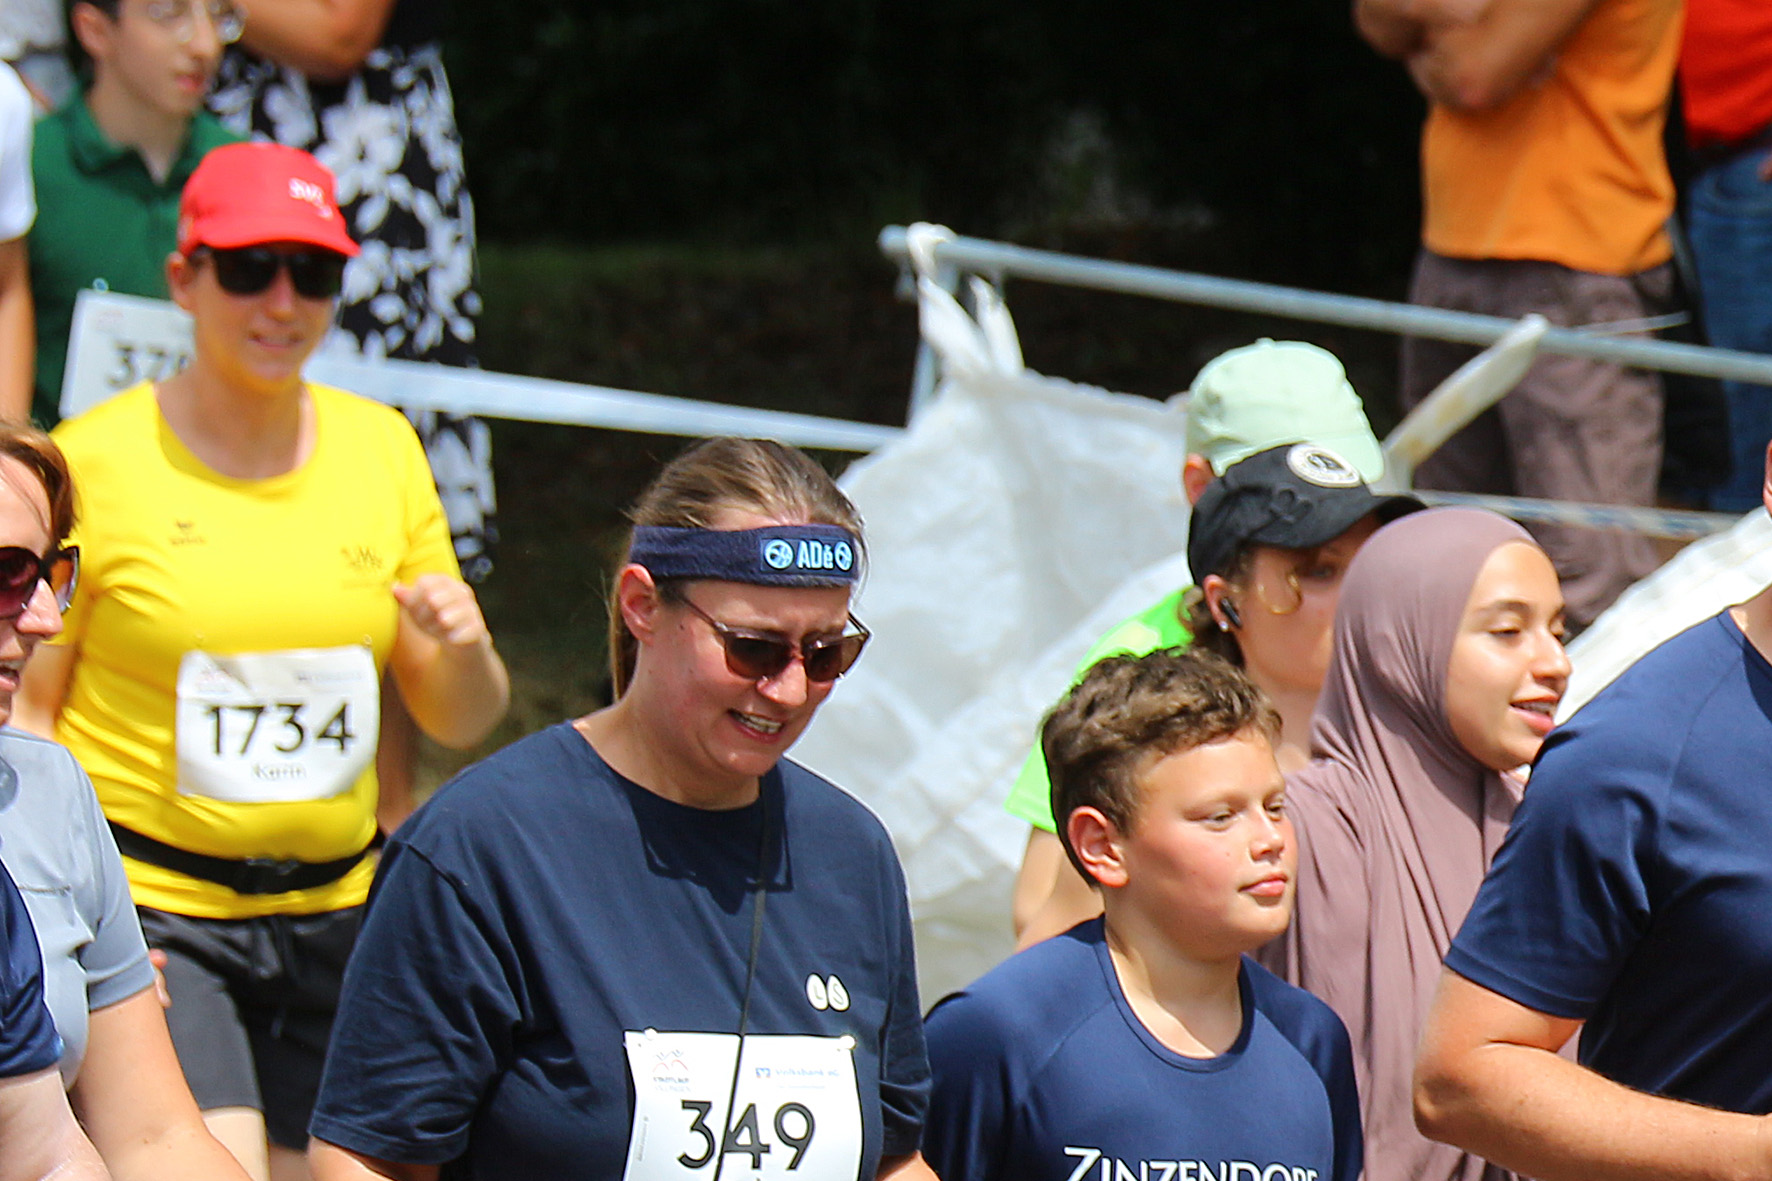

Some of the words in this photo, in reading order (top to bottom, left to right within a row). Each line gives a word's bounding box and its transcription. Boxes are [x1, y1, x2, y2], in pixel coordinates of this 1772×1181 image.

[205, 699, 356, 757] 1734
[256, 763, 305, 781] Karin
[677, 1099, 815, 1172] 349
